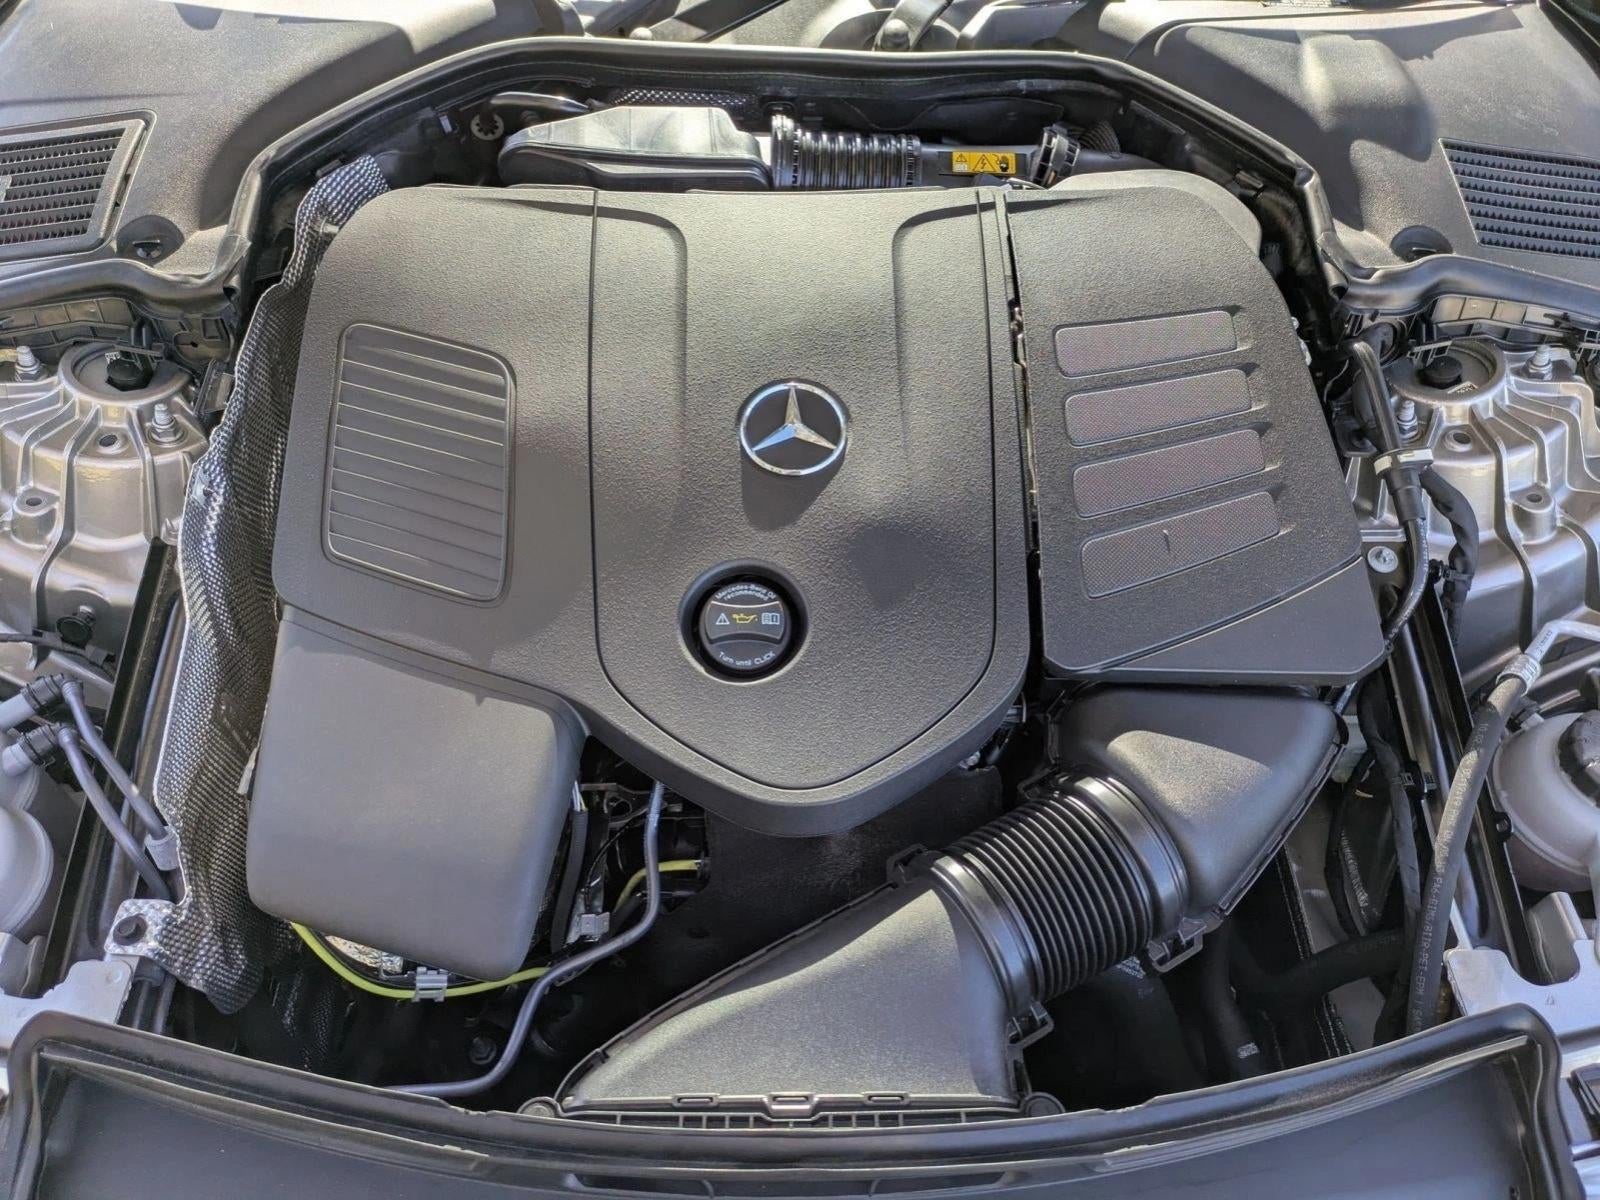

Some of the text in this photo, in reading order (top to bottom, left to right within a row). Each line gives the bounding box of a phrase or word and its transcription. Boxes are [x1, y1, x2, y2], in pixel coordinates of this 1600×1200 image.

[715, 584, 766, 599] Mercedes-Benz
[724, 591, 769, 600] recommended
[719, 651, 776, 666] Turn until CLICK
